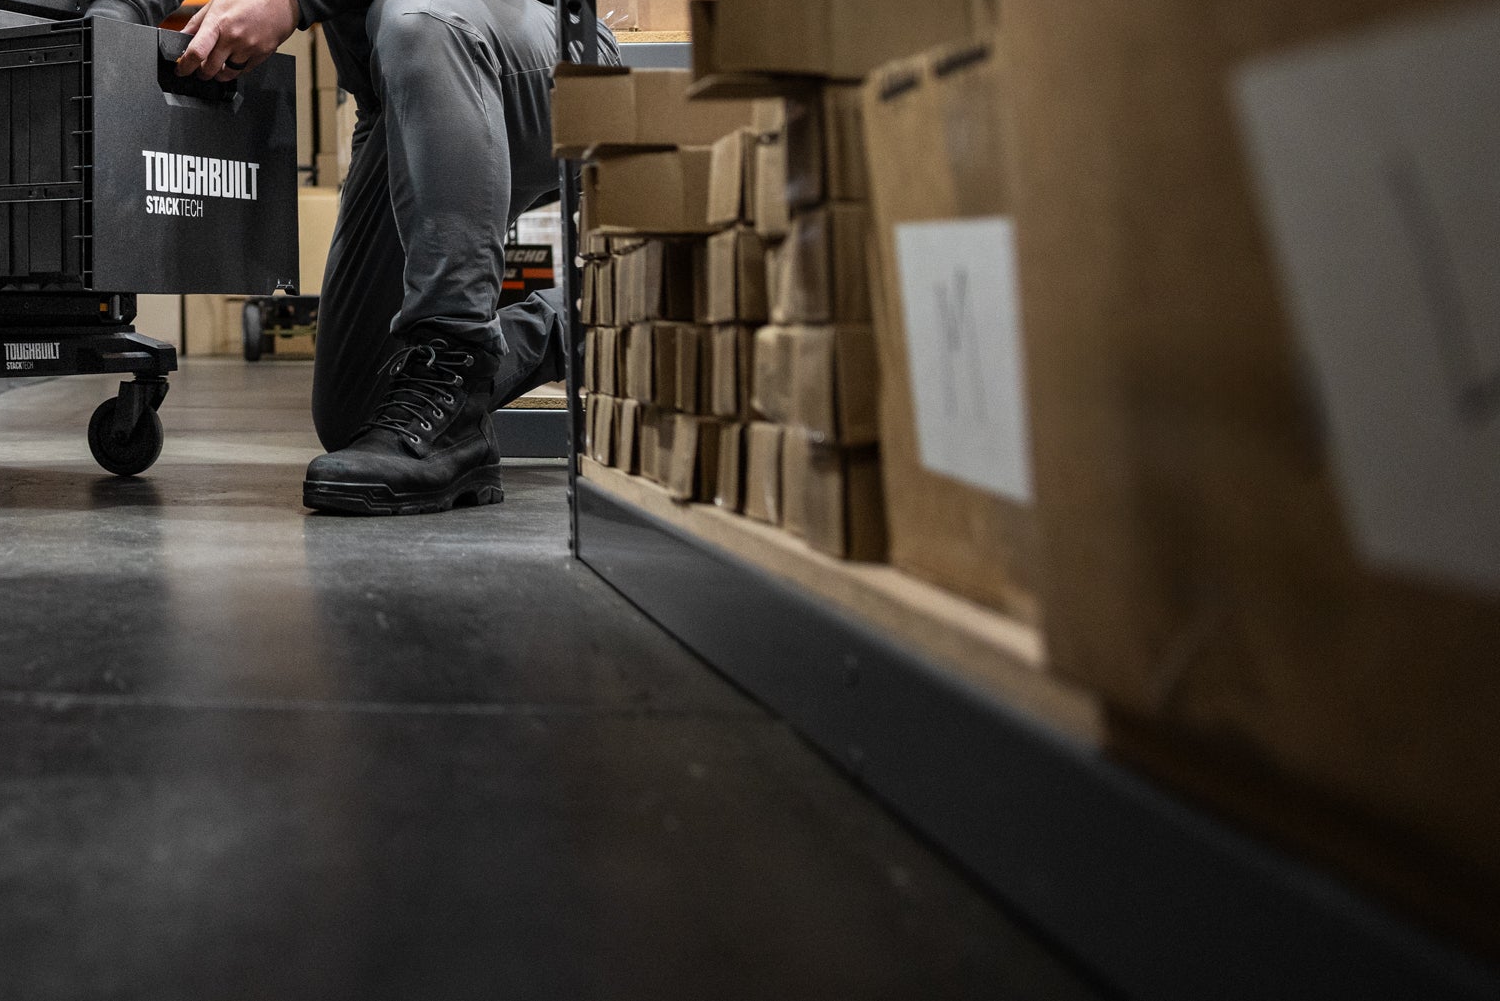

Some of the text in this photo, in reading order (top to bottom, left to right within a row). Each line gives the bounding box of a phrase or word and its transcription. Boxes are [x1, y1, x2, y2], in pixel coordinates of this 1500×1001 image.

[142, 150, 260, 201] TOUGHBUILT
[146, 195, 204, 218] STACKTECH
[3, 342, 61, 361] TOUGHBUILT
